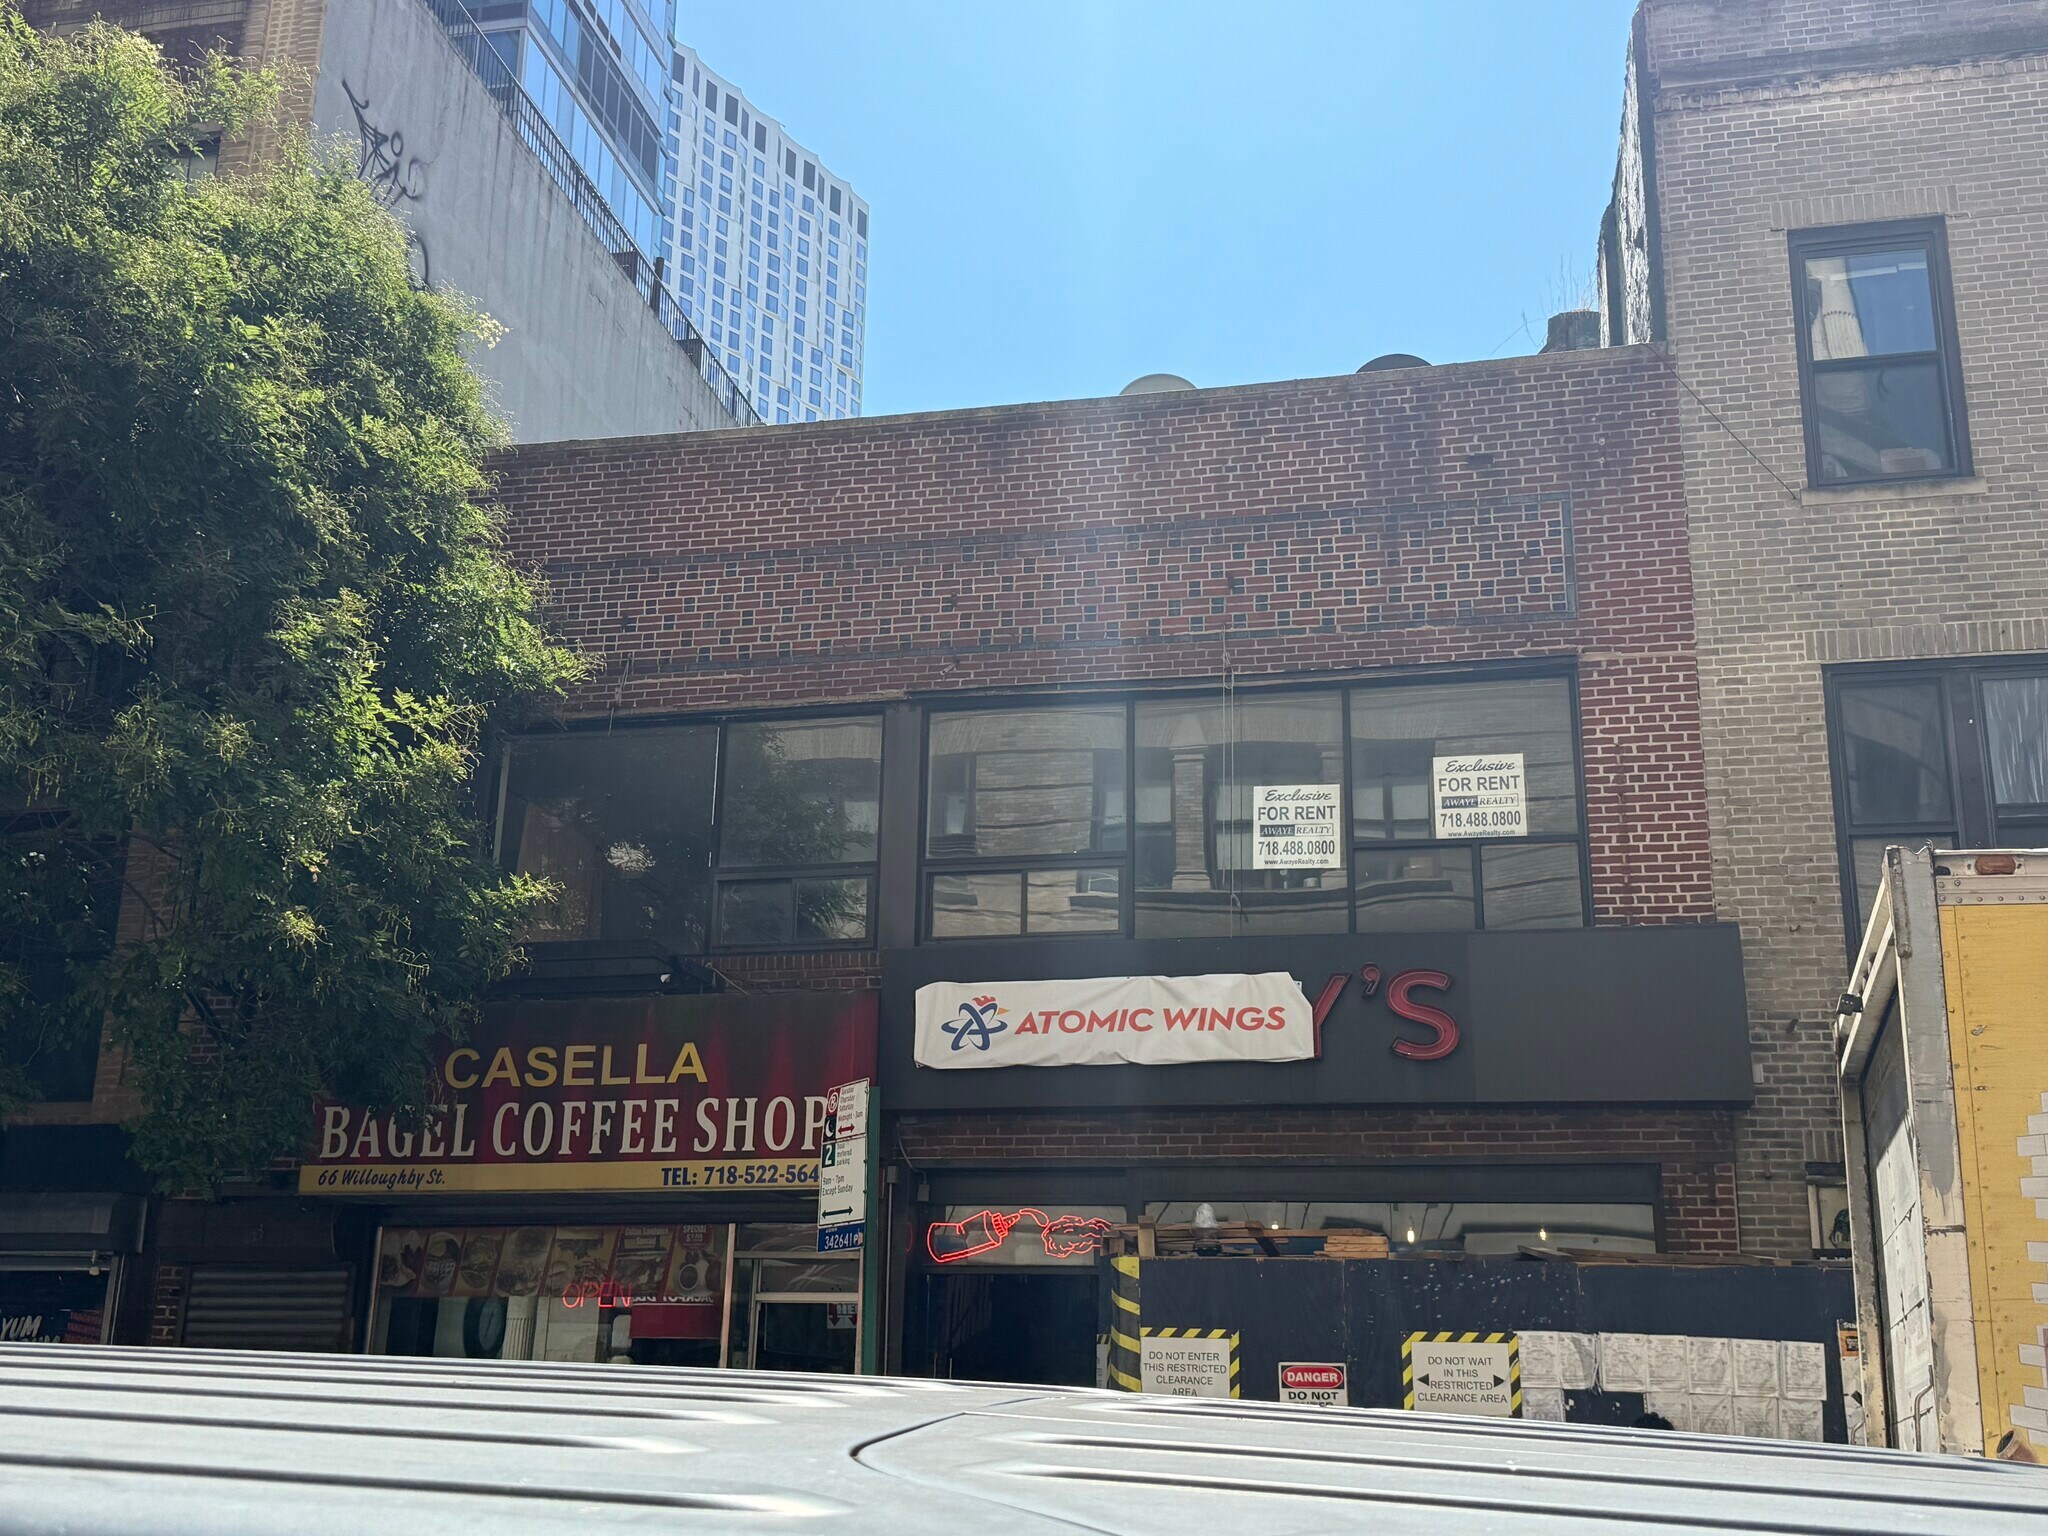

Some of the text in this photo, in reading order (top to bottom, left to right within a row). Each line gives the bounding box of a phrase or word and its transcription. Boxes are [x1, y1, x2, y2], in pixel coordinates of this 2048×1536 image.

[1445, 758, 1515, 773] Exclusive
[1438, 775, 1520, 792] FOR RENT
[1264, 788, 1332, 802] Exclusive
[1443, 795, 1516, 806] AWAYE REALTY
[1258, 805, 1336, 821] FOR RENT
[1440, 810, 1521, 828] 718.488.0800
[1261, 825, 1332, 835] AWAYE REALTY
[1447, 829, 1516, 838] www.AwayeRealty.com
[1258, 840, 1335, 856] 718.488.0800
[1264, 858, 1329, 866] www.AwayeRealty.com
[1014, 1006, 1286, 1035] ATOMIC WINGS
[444, 1041, 709, 1089] CASELLA
[318, 1096, 826, 1159] BAGEL COFFEE SHOP
[825, 1144, 833, 1166] 2
[317, 1167, 446, 1190] 66 Willoughby St.
[661, 1164, 820, 1186] TEL: 718-522-564
[822, 1184, 854, 1197] Except Sunday
[824, 1232, 852, 1250] 342641
[562, 1281, 632, 1308] OPEN
[0, 1314, 43, 1341] YUM
[1149, 1351, 1220, 1361] DO NOT ENTER
[1428, 1356, 1493, 1366] DO NOT WAIT
[1144, 1363, 1227, 1375] THIS RESTRICTED
[1443, 1369, 1479, 1378] IN THIS
[1156, 1375, 1214, 1386] CLEARANCE
[1287, 1371, 1339, 1383] DANGER
[1430, 1381, 1493, 1391] RESTRICTED
[1288, 1391, 1339, 1401] DO NOT
[1417, 1392, 1508, 1404] CLEARANCE AREA
